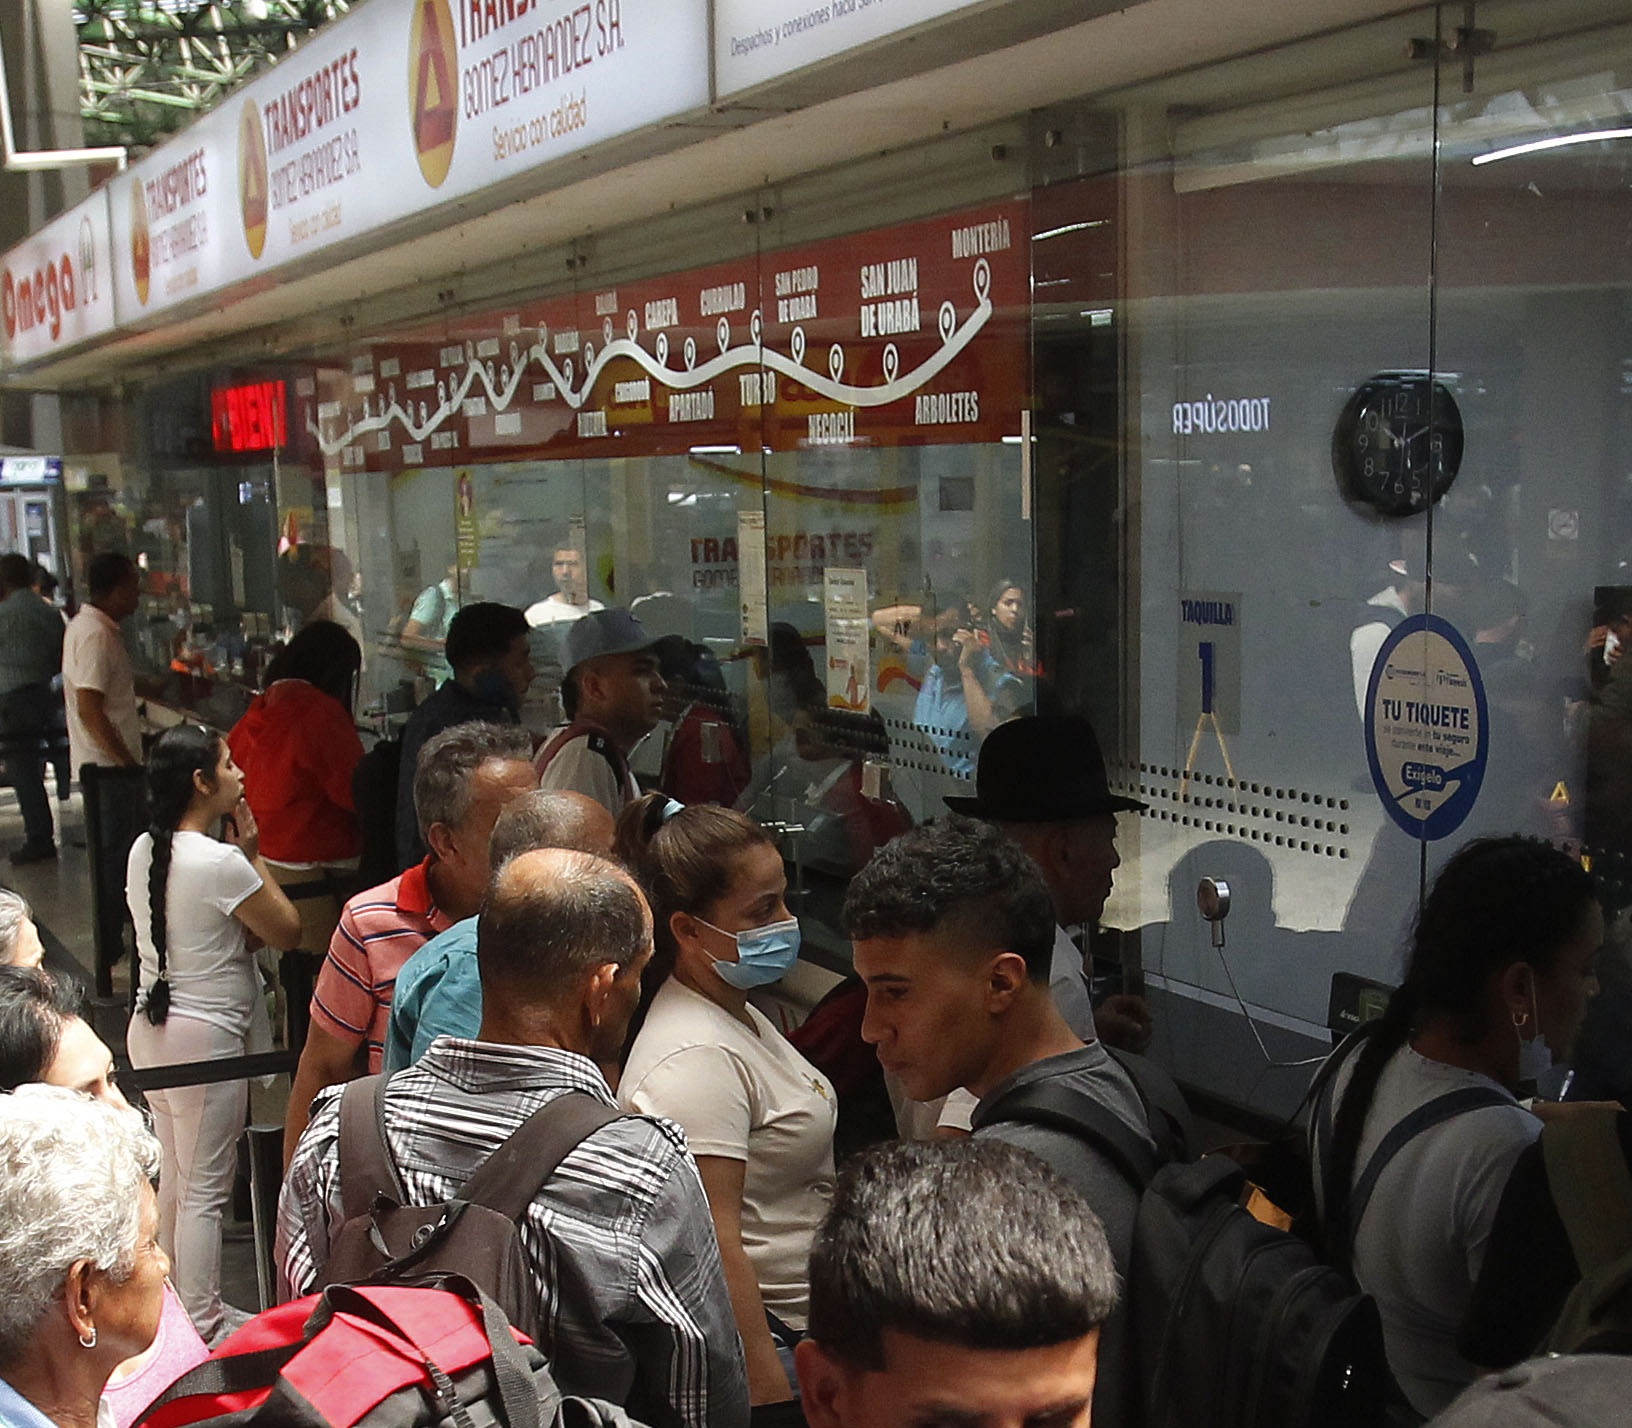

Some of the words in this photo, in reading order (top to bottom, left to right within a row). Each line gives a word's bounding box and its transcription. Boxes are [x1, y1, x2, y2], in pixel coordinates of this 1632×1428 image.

[731, 28, 773, 57] Despachos
[783, 7, 830, 37] conexiones
[464, 47, 509, 120] GOMEZ
[511, 4, 592, 98] HERNANDEZ
[264, 47, 359, 155] TRANSPORTES
[492, 112, 527, 160] Servicio
[529, 114, 549, 146] con
[550, 85, 587, 137] calidad
[146, 146, 206, 222] TRANSPORTES
[952, 215, 1011, 259] MONTERÍA
[1, 254, 75, 341] Omega
[775, 271, 791, 296] SAN
[792, 266, 818, 292] PEDRO
[861, 263, 884, 299] SAN
[887, 257, 917, 295] JUAN
[778, 299, 789, 323] DE
[789, 290, 817, 321] URABÁ
[861, 304, 877, 337] DE
[878, 292, 920, 336] URABÁ
[739, 370, 776, 406] TURBO
[915, 390, 979, 425] ARBOLETES
[808, 405, 855, 444] NECOCLÍ
[1182, 600, 1233, 626] TAQUILLA
[1199, 642, 1214, 714] 1
[1382, 699, 1402, 721] TU
[1406, 701, 1470, 729] TIQUETE
[1432, 730, 1441, 740] tu
[1443, 731, 1470, 745] seguro
